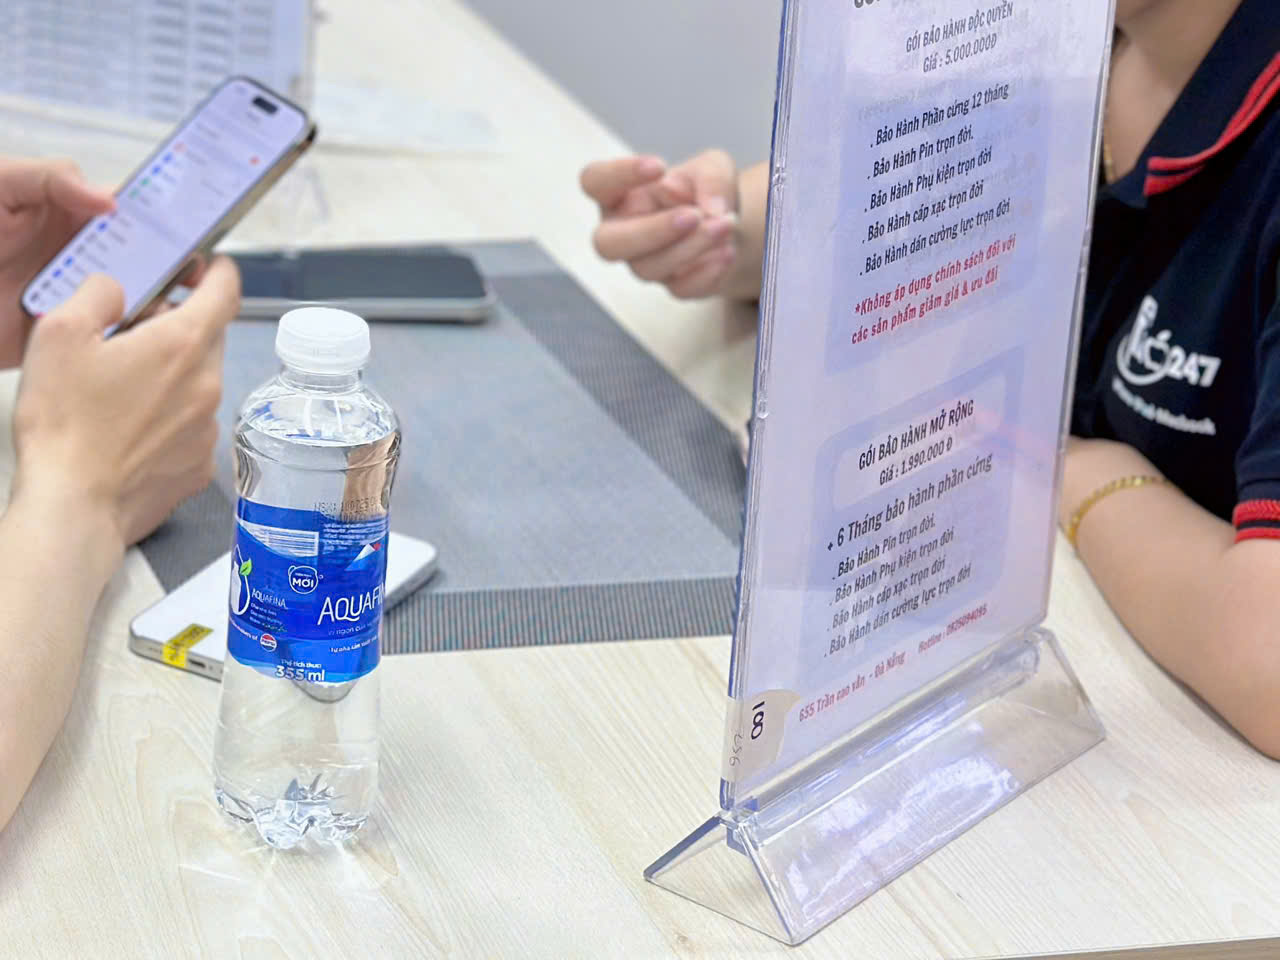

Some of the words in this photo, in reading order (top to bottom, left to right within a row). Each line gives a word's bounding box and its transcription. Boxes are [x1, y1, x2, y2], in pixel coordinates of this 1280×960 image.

[906, 30, 920, 53] GÓI
[923, 24, 940, 47] BẢO
[943, 18, 966, 40] HÀNH
[968, 9, 985, 32] ĐỘC
[986, 0, 1013, 26] QUYỀN
[923, 52, 938, 73] Giá
[876, 126, 893, 146] Bảo
[896, 116, 919, 138] Hành
[922, 107, 944, 128] Phần
[947, 99, 970, 116] cứng
[972, 91, 982, 110] 12
[984, 83, 1009, 104] tháng
[870, 190, 888, 210] Bảo
[890, 180, 913, 202] Hành
[916, 174, 934, 191] Phụ
[936, 163, 955, 184] kiện
[957, 157, 975, 176] trọn
[977, 145, 993, 166] đời
[873, 157, 890, 178] Bảo
[893, 148, 916, 170] Hành
[919, 141, 934, 160] Pin
[936, 135, 955, 154] trọn
[865, 252, 882, 273] Bảo
[884, 243, 908, 265] Hành
[910, 234, 926, 254] dán
[929, 223, 958, 246] cường
[960, 216, 974, 236] lực
[976, 210, 994, 227] trọn
[996, 198, 1011, 217] đời
[867, 221, 885, 242] Bảo
[887, 211, 911, 233] Hành
[913, 203, 929, 222] cáp
[948, 190, 967, 209] trọn
[969, 179, 984, 200] đời
[894, 282, 905, 301] áp
[908, 273, 933, 296] dụng
[935, 260, 961, 283] chính
[964, 249, 984, 271] sách
[1002, 233, 1016, 253] với
[852, 324, 868, 345] các
[871, 316, 888, 336] sản
[919, 294, 942, 318] giảm
[944, 285, 959, 307] giá
[971, 279, 983, 292] ưu
[859, 443, 876, 471] GÓI
[878, 434, 898, 461] BẢO
[900, 424, 927, 450] HÀNH
[929, 409, 947, 436] MỞ
[948, 400, 974, 427] RỘNG
[880, 464, 894, 486] Giá
[901, 440, 945, 475] 1.990.000
[837, 528, 845, 547] 6
[848, 511, 883, 542] Tháng
[885, 498, 905, 522] bảo
[908, 482, 935, 511] hành
[937, 469, 964, 499] phần
[966, 453, 993, 480] cứng
[835, 583, 852, 603] Bảo
[854, 570, 877, 593] Hành
[879, 561, 896, 579] Phụ
[898, 551, 917, 569] kiện
[919, 539, 938, 559] trọn
[838, 556, 855, 577] Bảo
[857, 544, 880, 568] Hành
[882, 535, 896, 554] Pin
[899, 525, 917, 546] trọn
[251, 588, 288, 610] AQUAFINA
[832, 608, 850, 629] Bảo
[851, 595, 874, 618] Hành
[876, 586, 892, 605] cáp
[910, 565, 929, 587] trọn
[829, 634, 846, 655] Bảo
[848, 621, 871, 644] Hành
[275, 665, 305, 681] 355
[308, 669, 325, 681] ml
